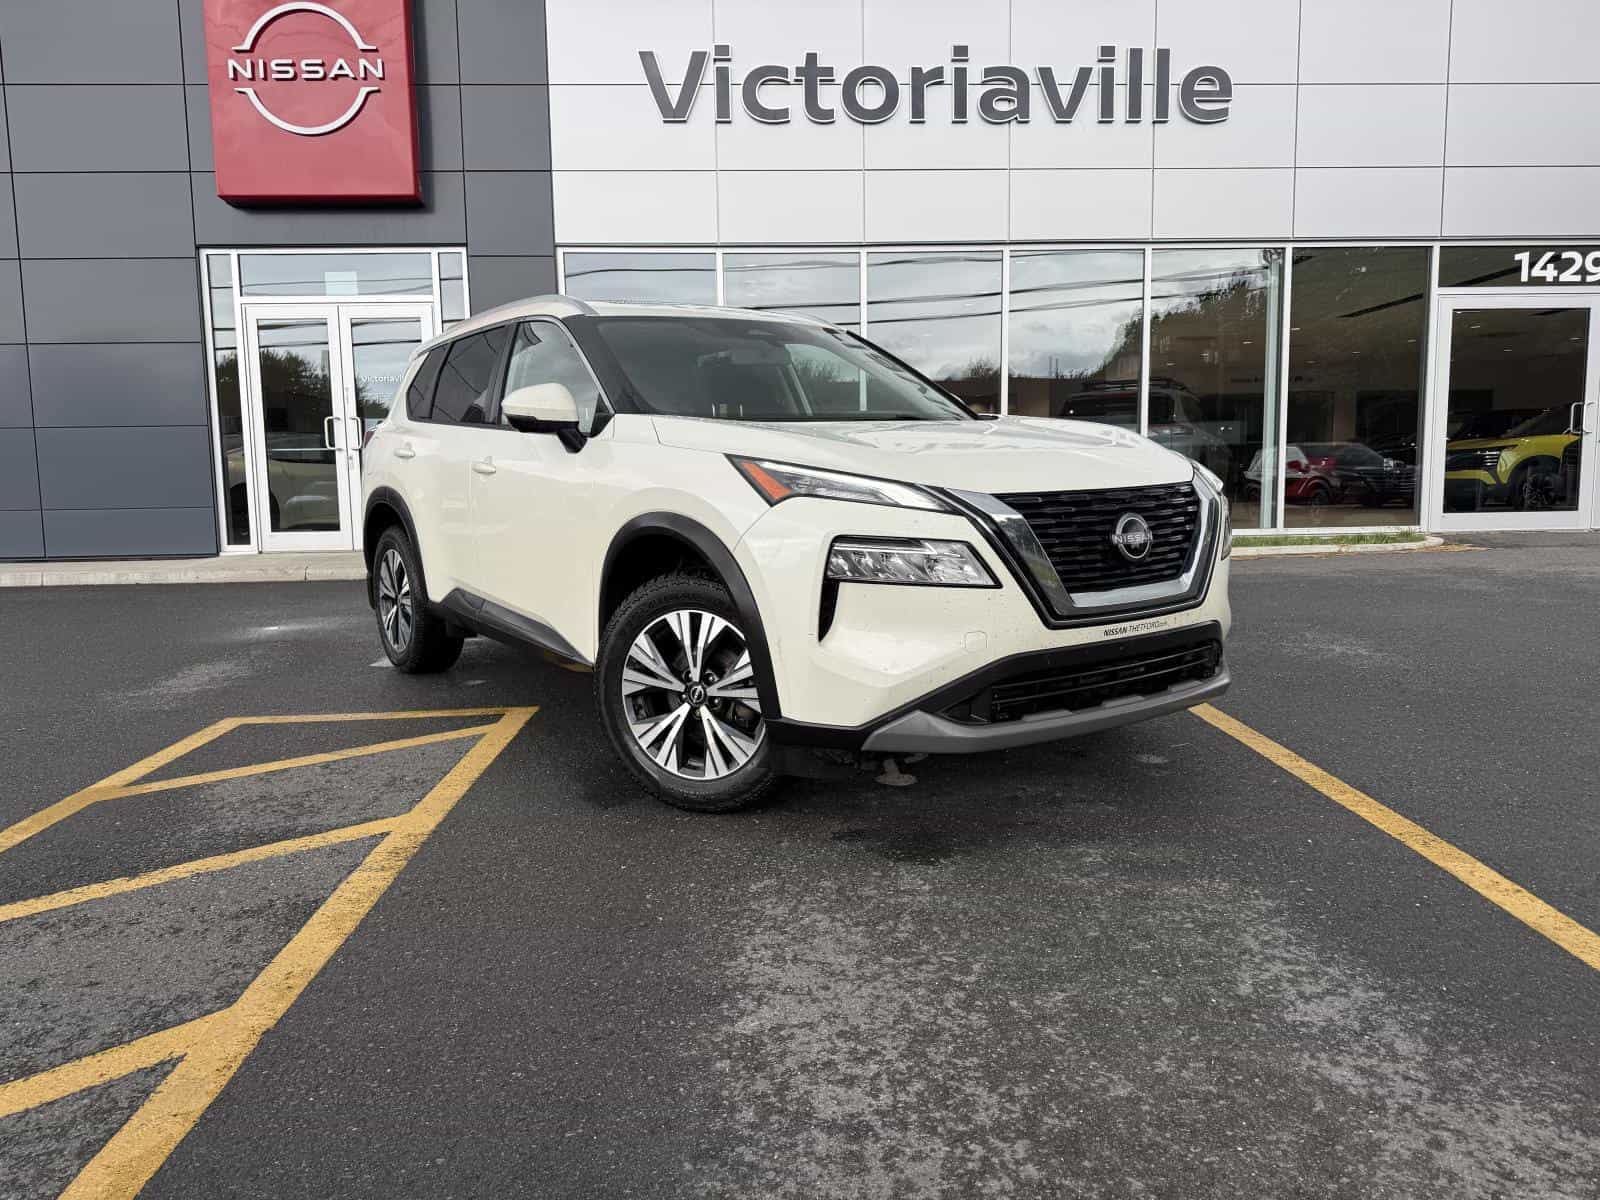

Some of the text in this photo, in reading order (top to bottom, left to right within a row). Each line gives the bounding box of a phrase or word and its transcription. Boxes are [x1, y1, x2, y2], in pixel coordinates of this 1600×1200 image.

[227, 58, 385, 80] NISSAN
[638, 44, 1233, 125] Victoriaville
[1514, 251, 1600, 282] 1429
[1103, 625, 1128, 637] NISSAN
